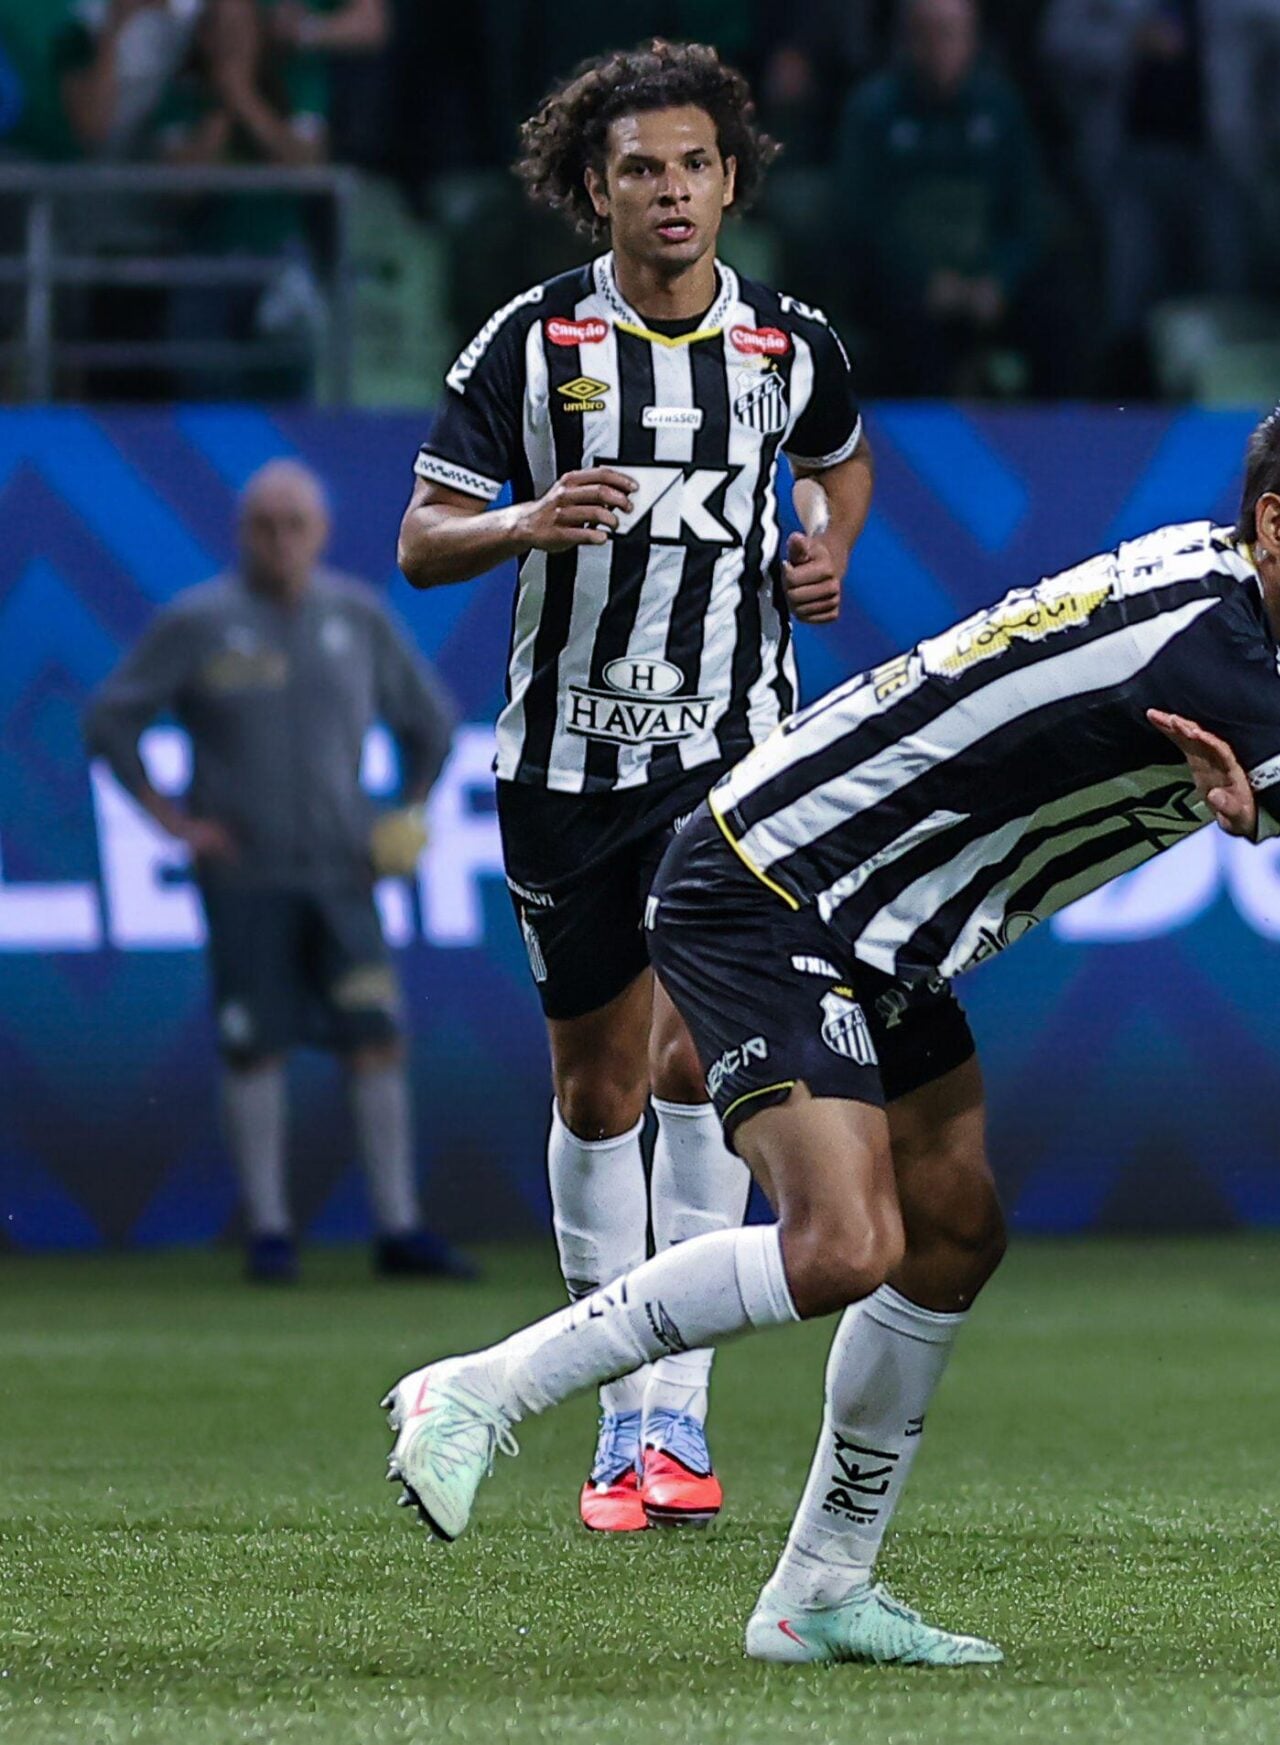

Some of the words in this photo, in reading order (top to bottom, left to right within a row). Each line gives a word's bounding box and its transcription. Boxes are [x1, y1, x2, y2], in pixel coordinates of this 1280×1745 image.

[548, 321, 606, 342] Canção
[732, 330, 786, 350] Canção
[563, 399, 606, 413] umbro
[630, 664, 656, 691] H
[570, 695, 710, 738] HAVAN
